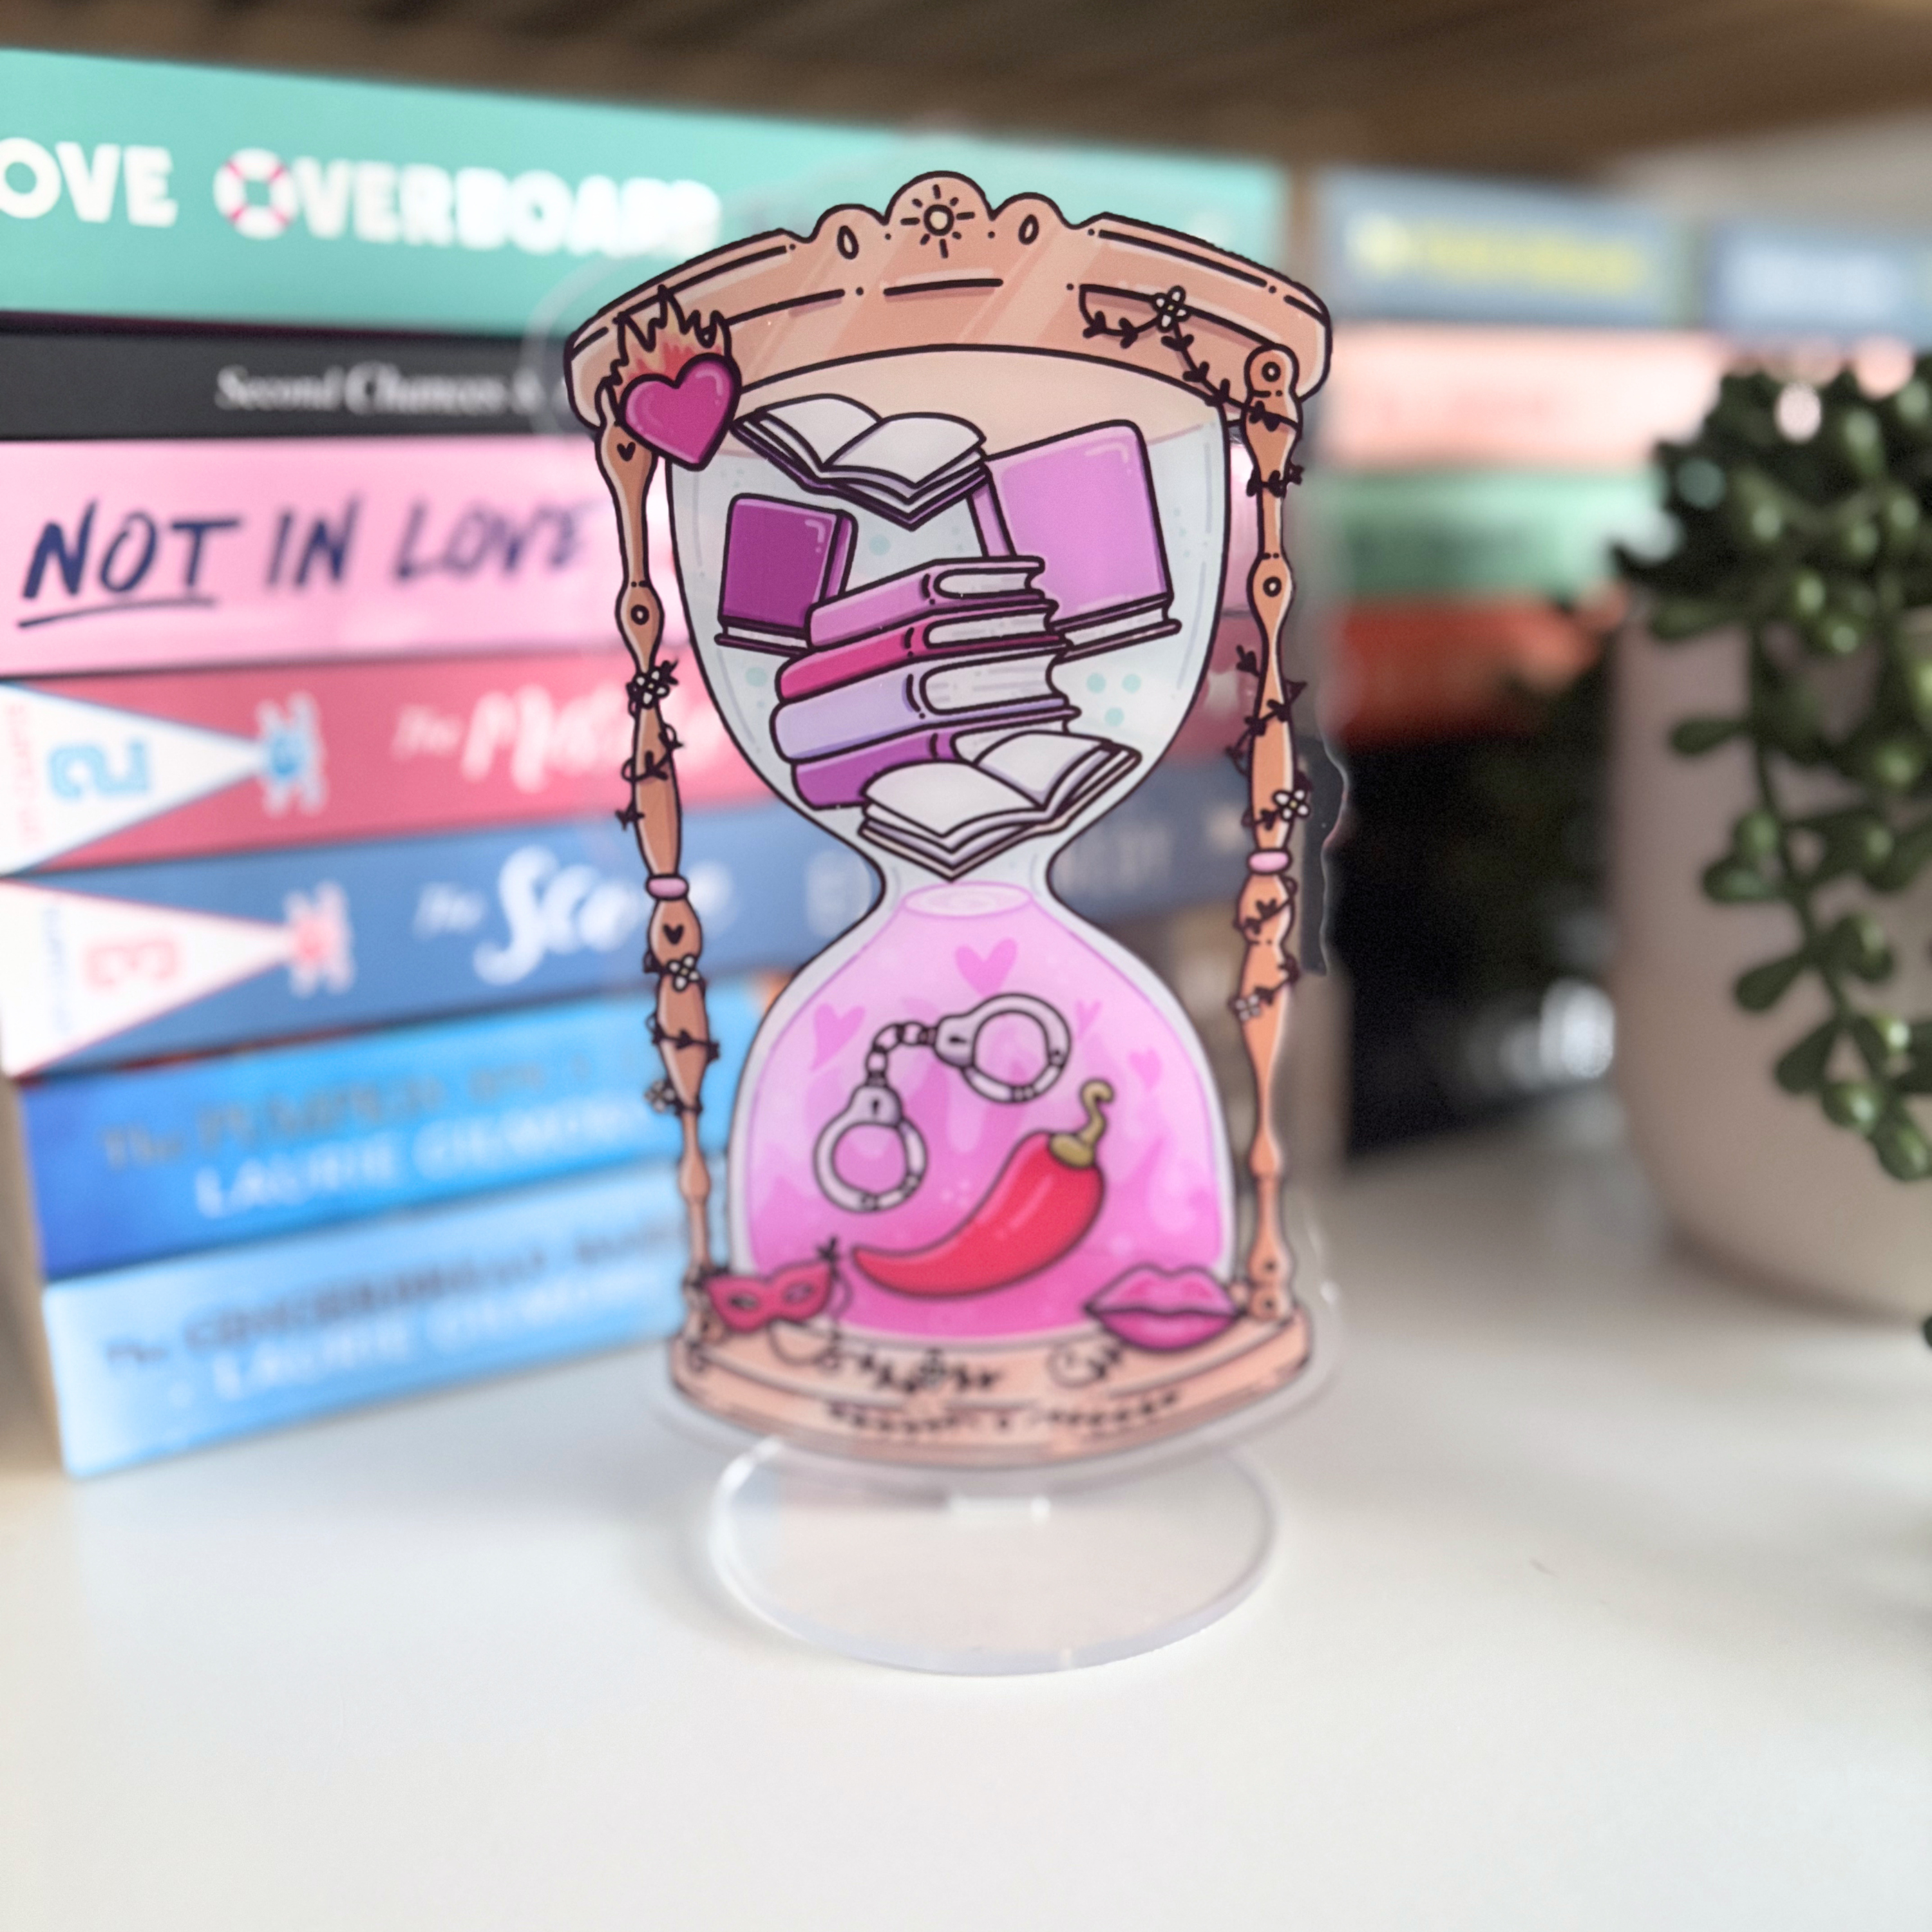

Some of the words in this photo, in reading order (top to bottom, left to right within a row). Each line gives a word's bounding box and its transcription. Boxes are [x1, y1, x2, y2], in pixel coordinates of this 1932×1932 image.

[0, 137, 178, 228] OVE
[22, 499, 241, 600] NOT
[265, 497, 363, 589] IN
[390, 500, 599, 586] LOVE
